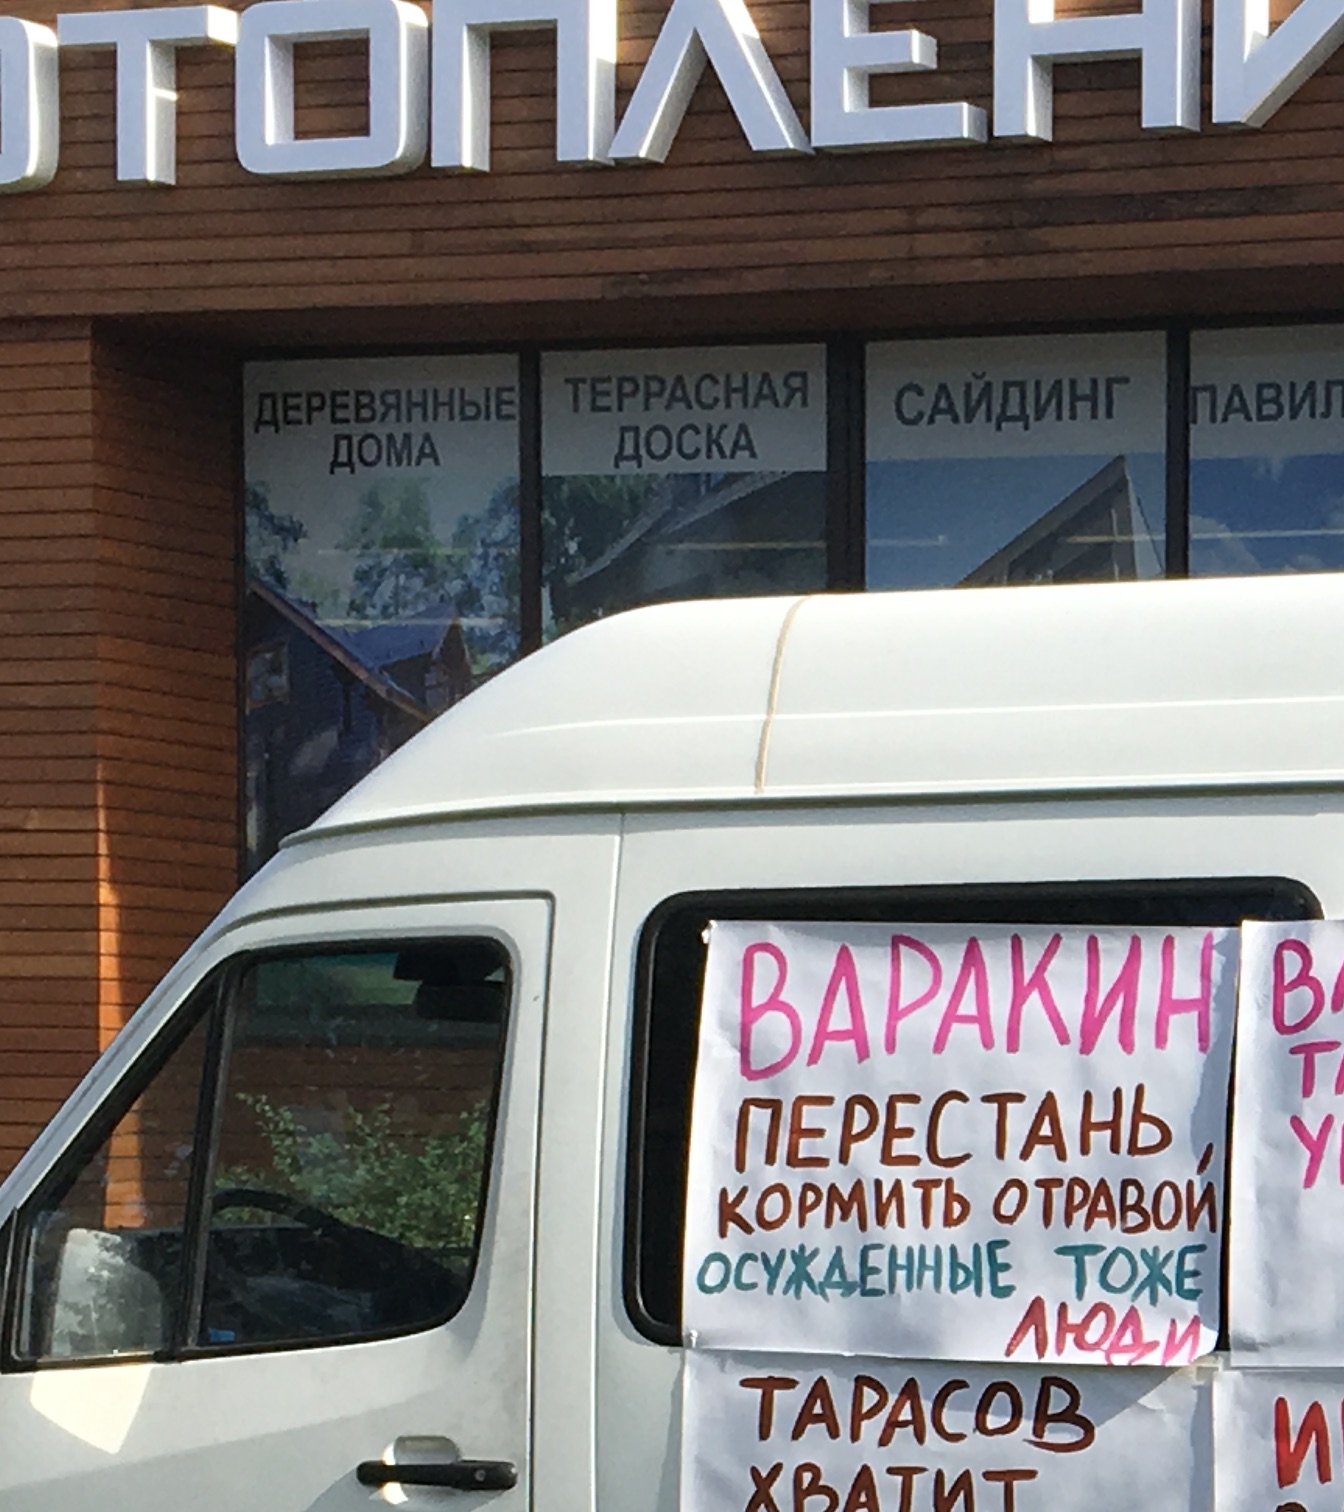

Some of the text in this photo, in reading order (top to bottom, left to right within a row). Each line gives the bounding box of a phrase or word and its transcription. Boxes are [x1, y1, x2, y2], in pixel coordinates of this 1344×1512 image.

[254, 383, 518, 434] ДЕРЕВЯННЫЕ
[564, 369, 810, 416] ТЕРРАСНАЯ
[893, 371, 1131, 432] САЙДИНГ
[330, 432, 442, 474] ДОМА
[613, 420, 758, 469] ДОСКА
[739, 932, 1215, 1081] ВАРАКИН
[718, 1143, 1218, 1239] КОРМИТЬ ОТРАВОЙ
[696, 1238, 1208, 1306] ОСУЖДЕННЫЕ ТОЖЕ
[1004, 1296, 1201, 1365] ЛЮДИ
[739, 1374, 1096, 1453] ТАРАСОВ
